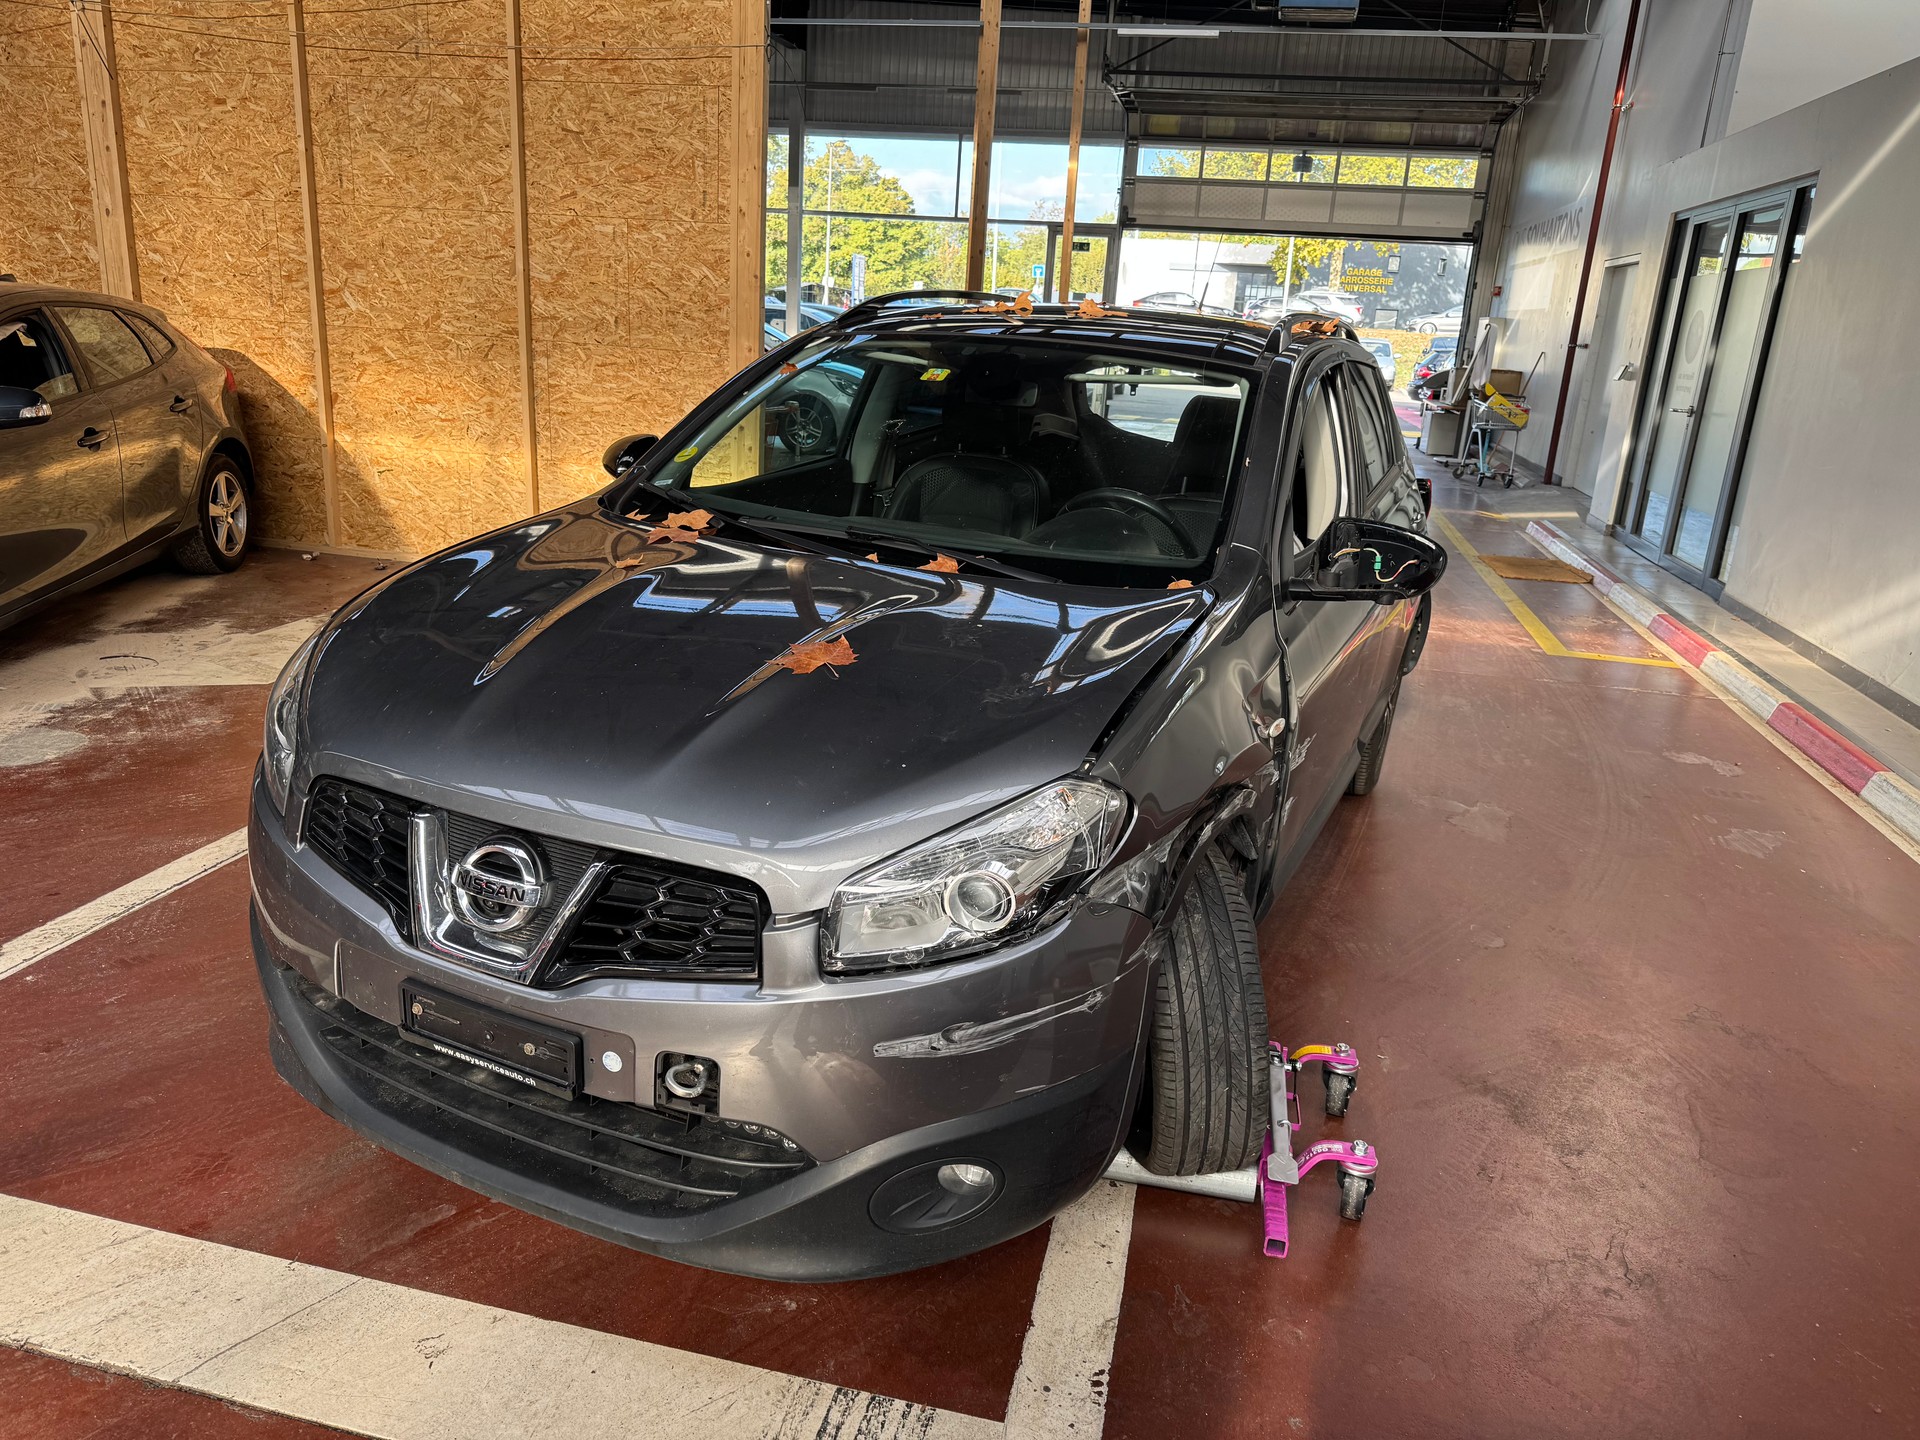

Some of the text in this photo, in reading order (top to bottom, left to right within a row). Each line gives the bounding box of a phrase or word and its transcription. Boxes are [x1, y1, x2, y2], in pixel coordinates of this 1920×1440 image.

[1346, 267, 1382, 276] GARAGE
[1340, 275, 1394, 285] ARROSSERIE
[1343, 284, 1387, 294] NIVERSAL
[456, 869, 526, 902] NISSAN
[433, 1043, 537, 1087] www.easyserviceauto.ch
